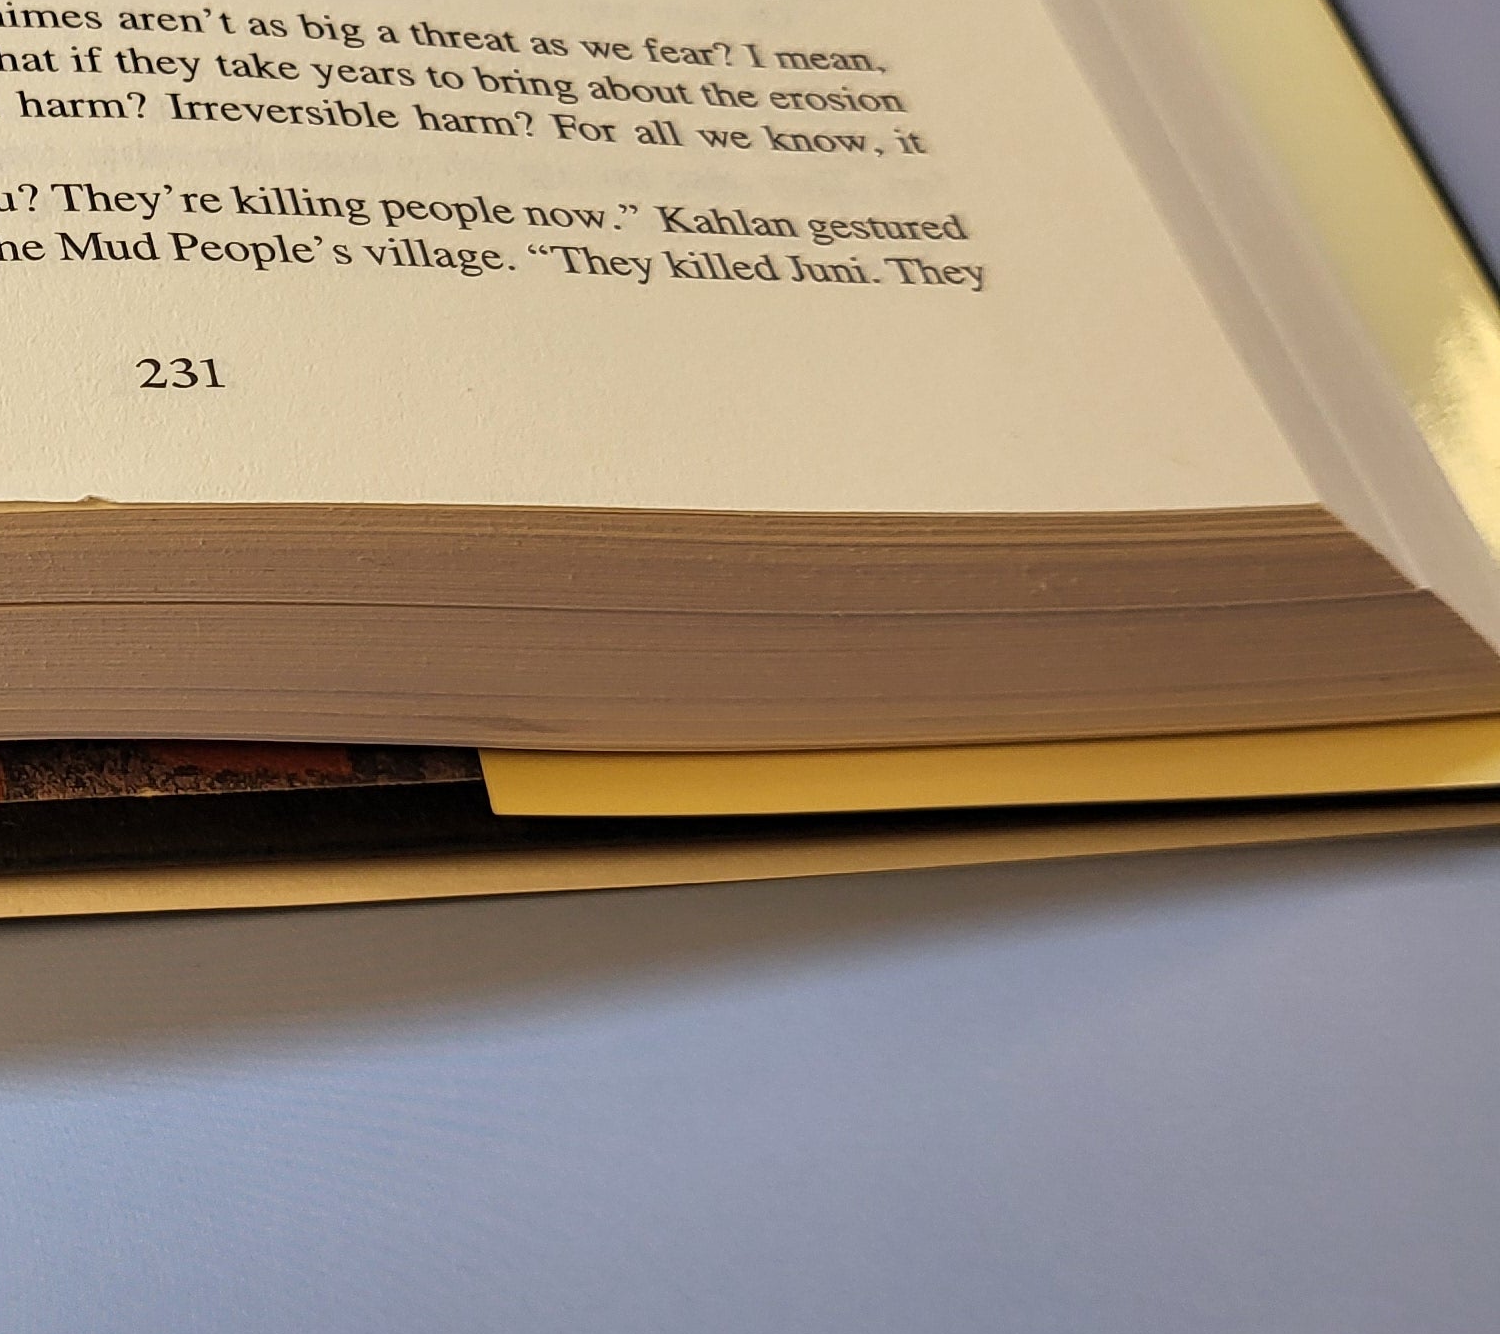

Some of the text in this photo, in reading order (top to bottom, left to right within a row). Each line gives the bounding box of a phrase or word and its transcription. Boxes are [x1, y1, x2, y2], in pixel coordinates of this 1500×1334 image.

[118, 8, 238, 36] aren’t
[247, 17, 288, 38] as
[296, 13, 365, 49] big
[377, 25, 401, 44] a
[408, 21, 522, 54] threat
[529, 36, 569, 57] as
[578, 40, 634, 61] we
[642, 37, 733, 67] fear?
[743, 43, 772, 68] I
[775, 47, 888, 76] mean,
[15, 90, 147, 119] harm?
[164, 92, 400, 129] Irreversible
[411, 103, 534, 137] harm?
[547, 113, 617, 143] For
[634, 119, 685, 147] all
[695, 129, 753, 150] we
[760, 124, 885, 156] know,
[893, 128, 927, 154] it
[50, 182, 223, 220] They’re
[235, 186, 372, 227] killing
[378, 195, 515, 231] people
[522, 203, 640, 232] now.”
[654, 205, 798, 241] Kahlan
[810, 213, 970, 247] gestured
[54, 231, 161, 261] Mud
[167, 231, 354, 272] People’s
[361, 237, 517, 278] village.
[527, 243, 653, 285] “They
[666, 250, 782, 283] killed
[790, 254, 882, 285] Juni.
[885, 257, 984, 293] They
[135, 356, 228, 390] 231
